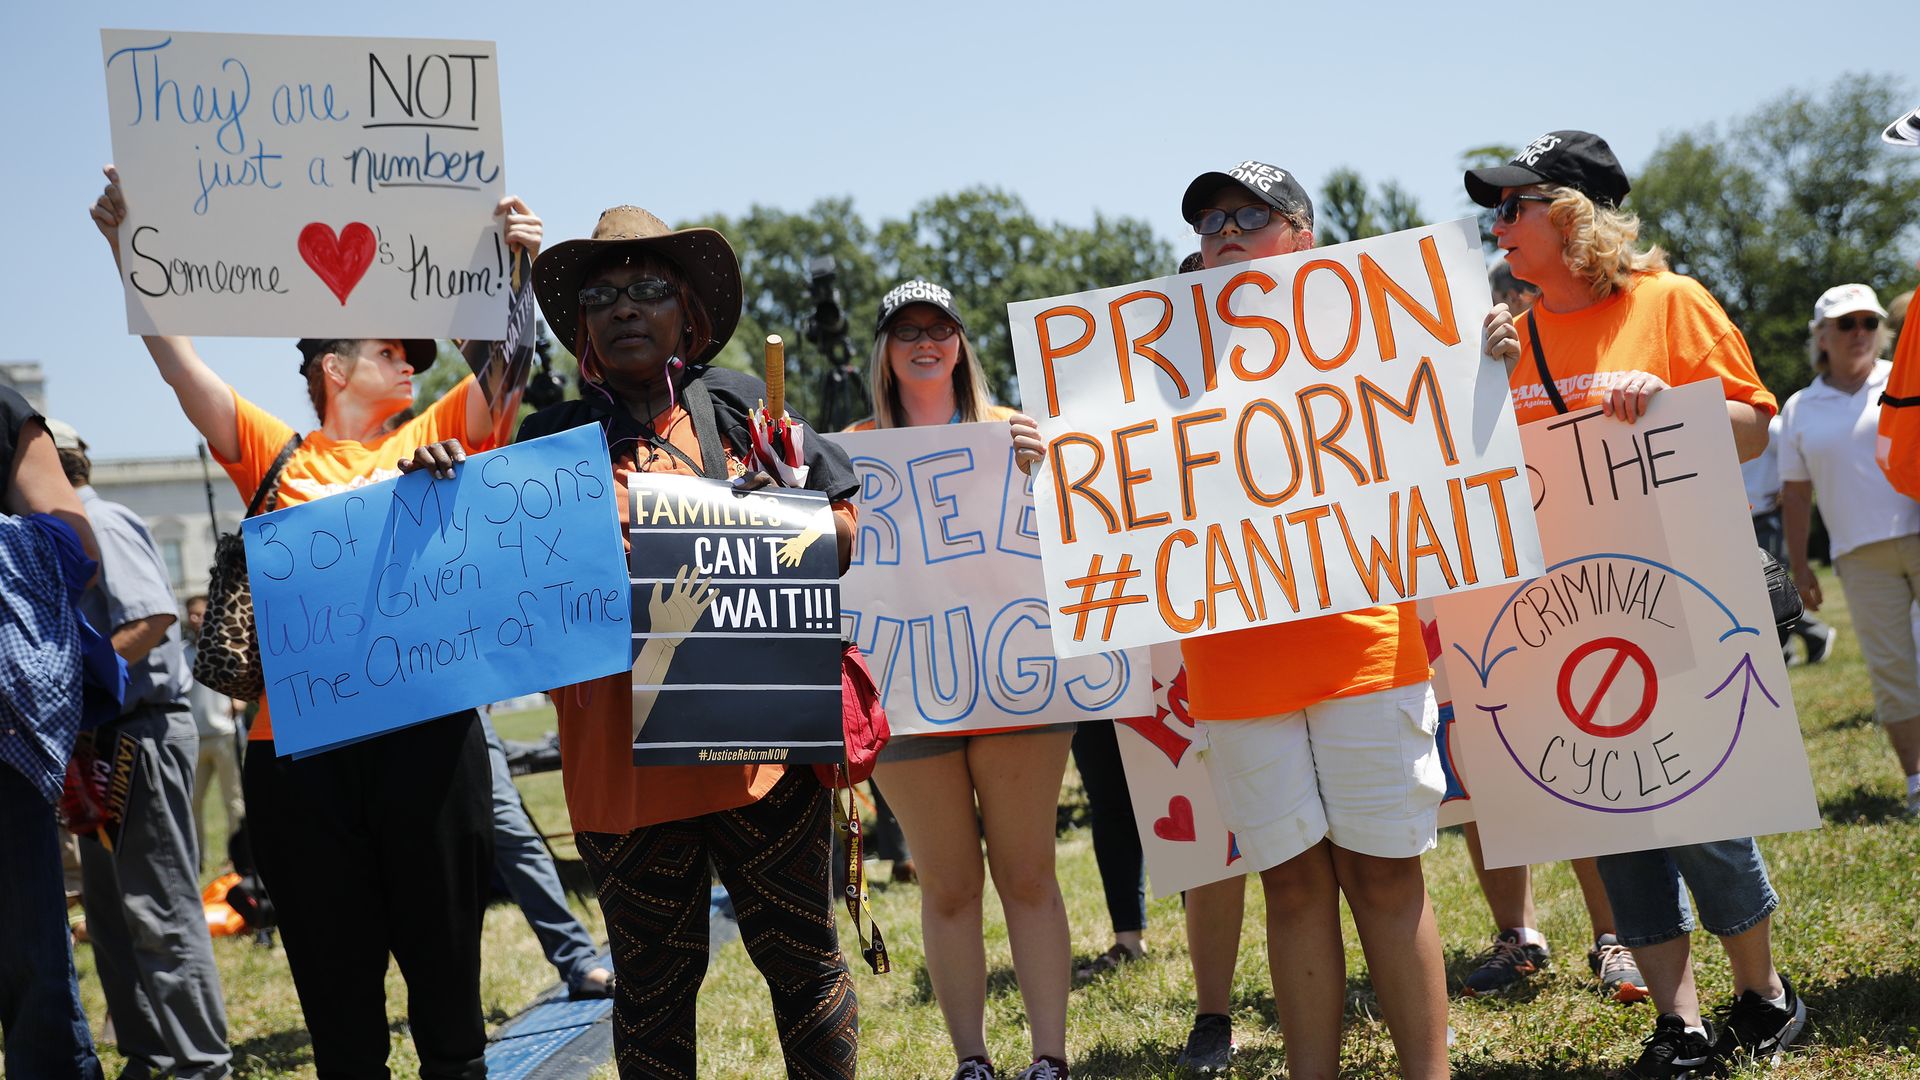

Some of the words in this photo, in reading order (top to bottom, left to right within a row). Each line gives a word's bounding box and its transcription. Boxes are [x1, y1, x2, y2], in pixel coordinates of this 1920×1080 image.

[107, 37, 250, 154] They
[272, 84, 349, 126] are
[369, 53, 489, 122] NOT
[194, 140, 282, 215] just
[308, 157, 333, 187] a
[343, 133, 499, 193] number
[1228, 168, 1272, 192] ONG
[1242, 160, 1285, 183] HES
[131, 226, 289, 297] Someone
[397, 233, 504, 301] them!
[1034, 235, 1461, 418] PRISON
[1048, 356, 1459, 545] REFORM
[1547, 408, 1699, 506] THE
[258, 522, 294, 580] 3
[391, 481, 470, 564] My
[482, 454, 604, 525] Sons
[636, 490, 782, 527] FAMILIES
[694, 536, 786, 576] CAN'T
[265, 594, 365, 657] Was
[376, 562, 481, 618] Given
[707, 587, 834, 629] WAIT!!!
[1512, 562, 1675, 649] CRIMINAL
[274, 670, 359, 717] The
[497, 590, 538, 647] of
[544, 580, 623, 635] Time
[698, 748, 789, 762] #JusticeReformNOW
[1539, 731, 1691, 802] CYCLE
[848, 836, 859, 884] REDSKINS
